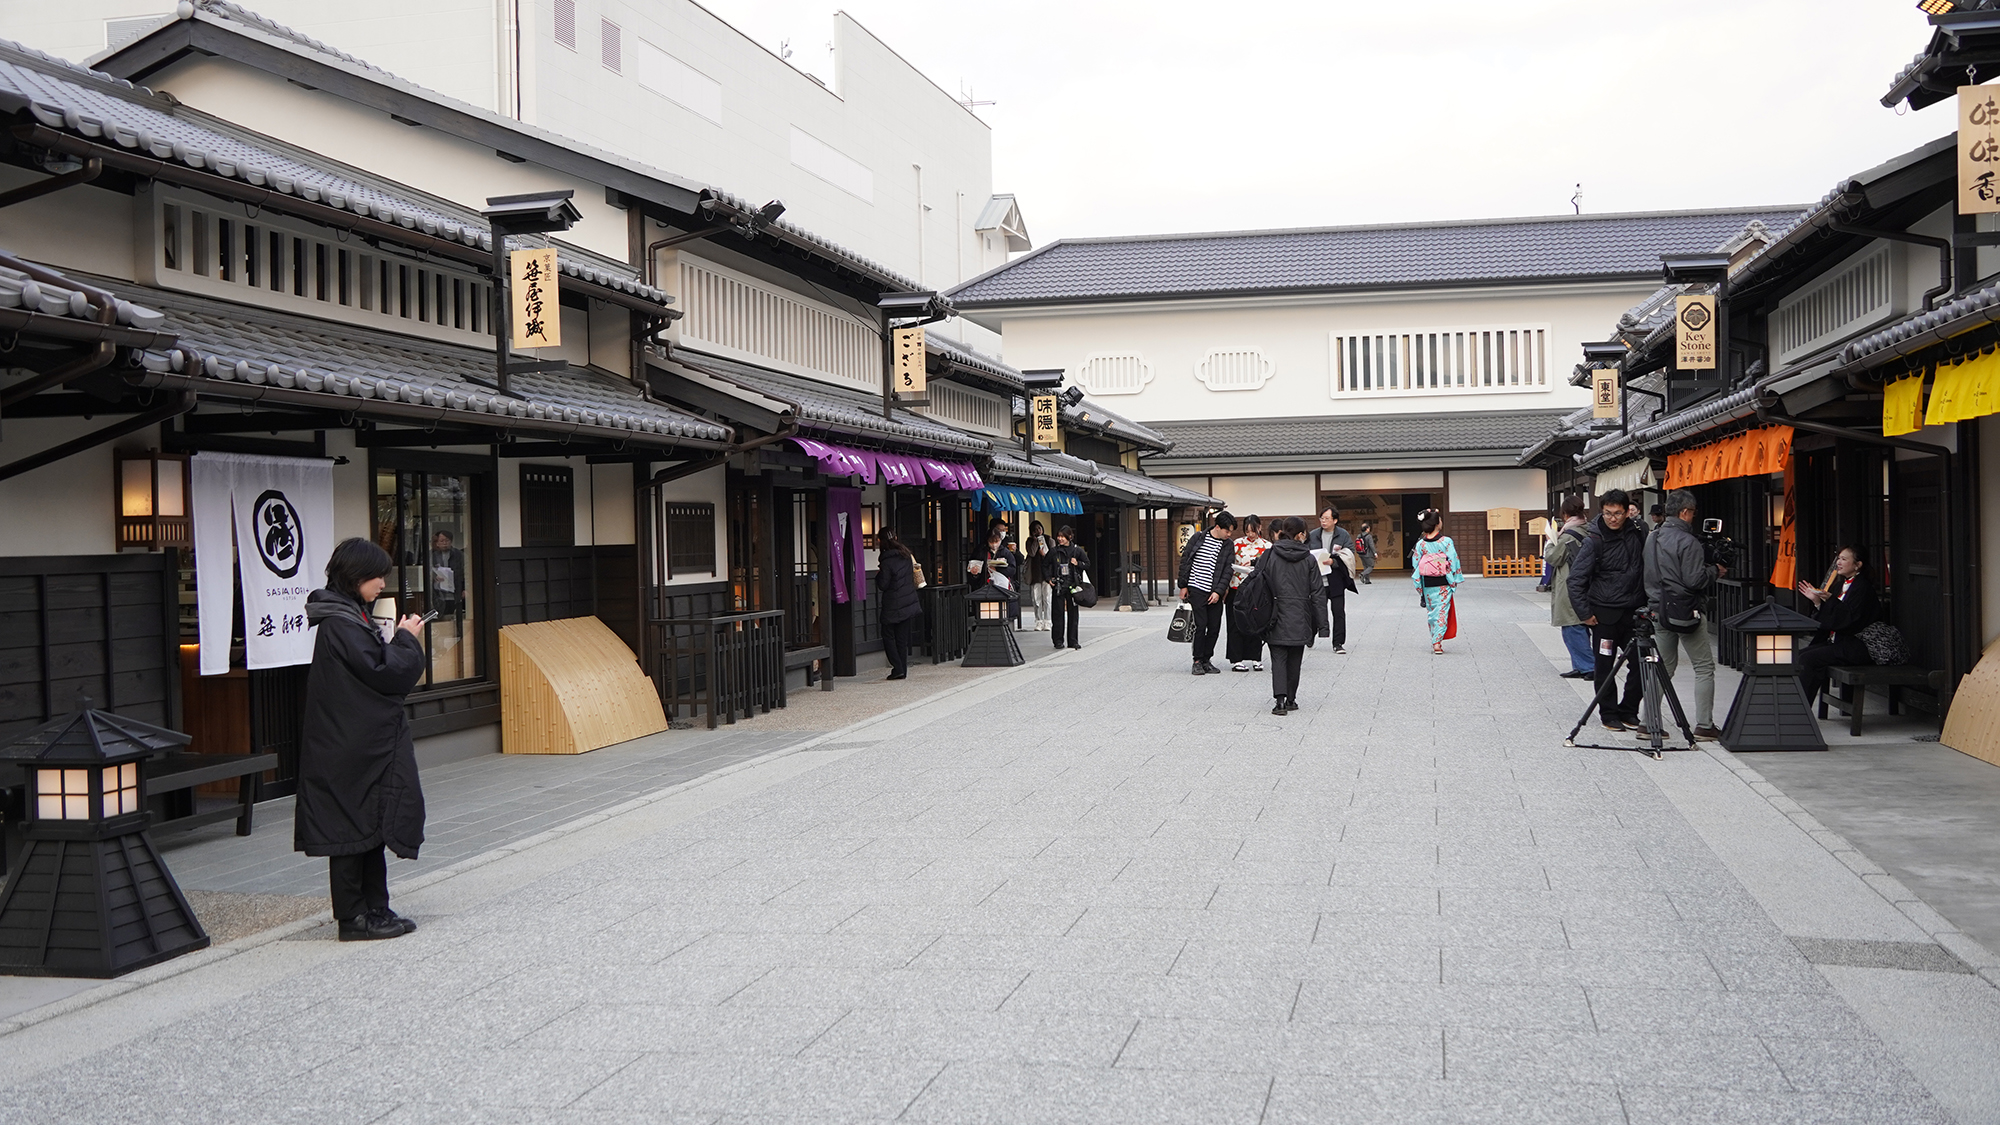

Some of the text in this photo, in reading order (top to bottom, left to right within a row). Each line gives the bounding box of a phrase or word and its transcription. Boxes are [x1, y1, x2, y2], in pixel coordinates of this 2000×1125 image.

[1685, 331, 1706, 343] Key
[1680, 341, 1711, 351] Stone
[902, 333, 914, 387] ござる
